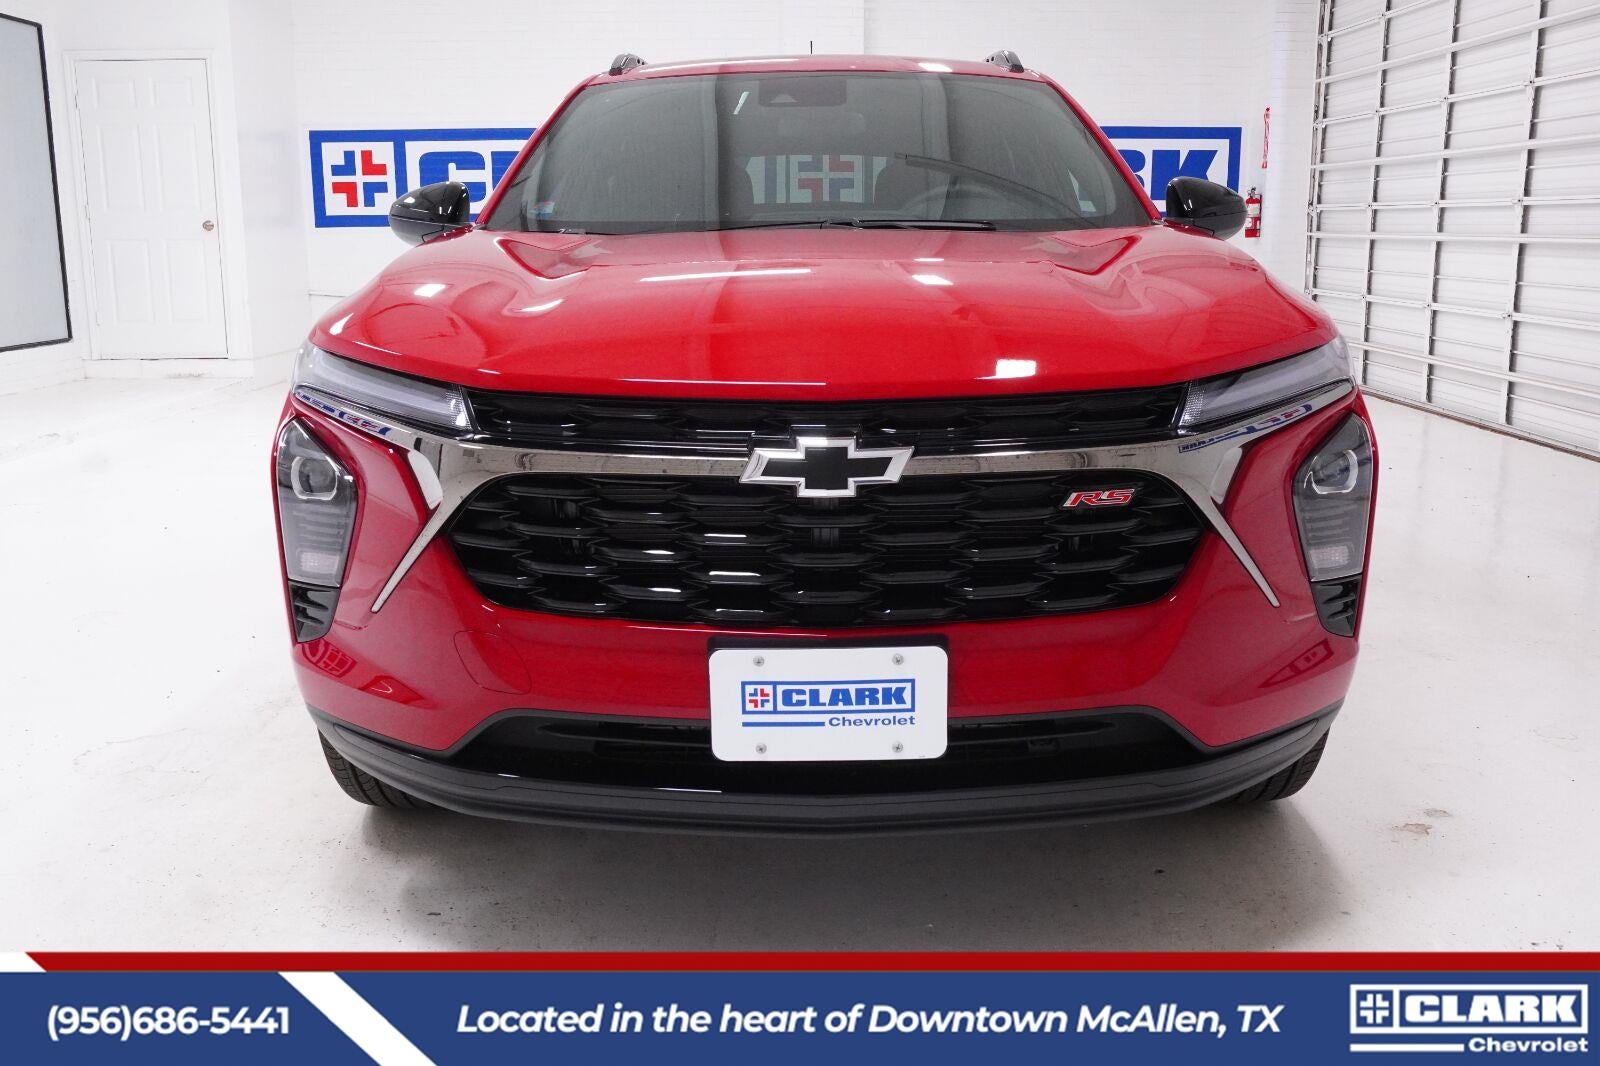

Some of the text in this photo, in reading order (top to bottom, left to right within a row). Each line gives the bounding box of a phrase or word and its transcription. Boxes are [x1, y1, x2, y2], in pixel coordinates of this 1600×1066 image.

[1063, 488, 1135, 506] RS
[781, 686, 907, 707] CLARK
[828, 715, 916, 727] Chevrolet
